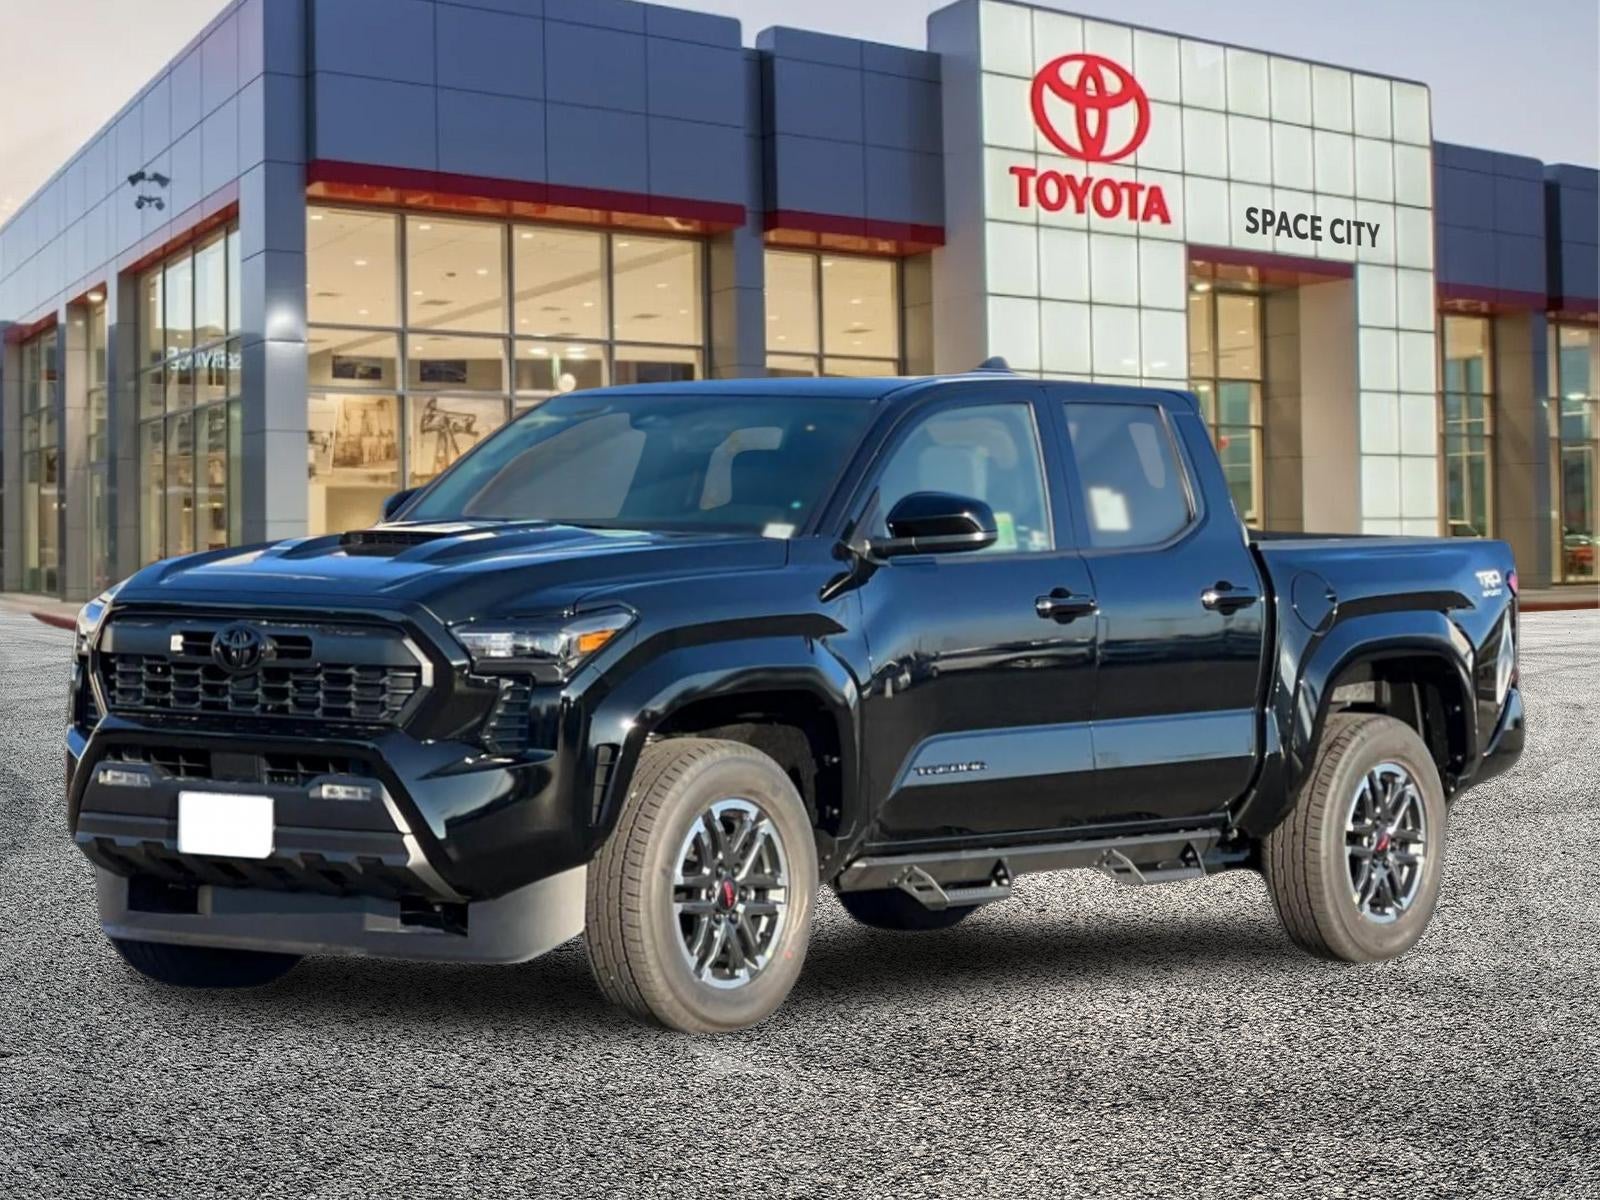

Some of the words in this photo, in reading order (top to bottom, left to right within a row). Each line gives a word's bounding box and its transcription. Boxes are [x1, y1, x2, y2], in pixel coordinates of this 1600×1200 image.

[1009, 166, 1171, 224] TOYOTA
[1245, 207, 1323, 242] SPACE
[1329, 218, 1380, 248] CITY
[1475, 569, 1502, 588] TRD
